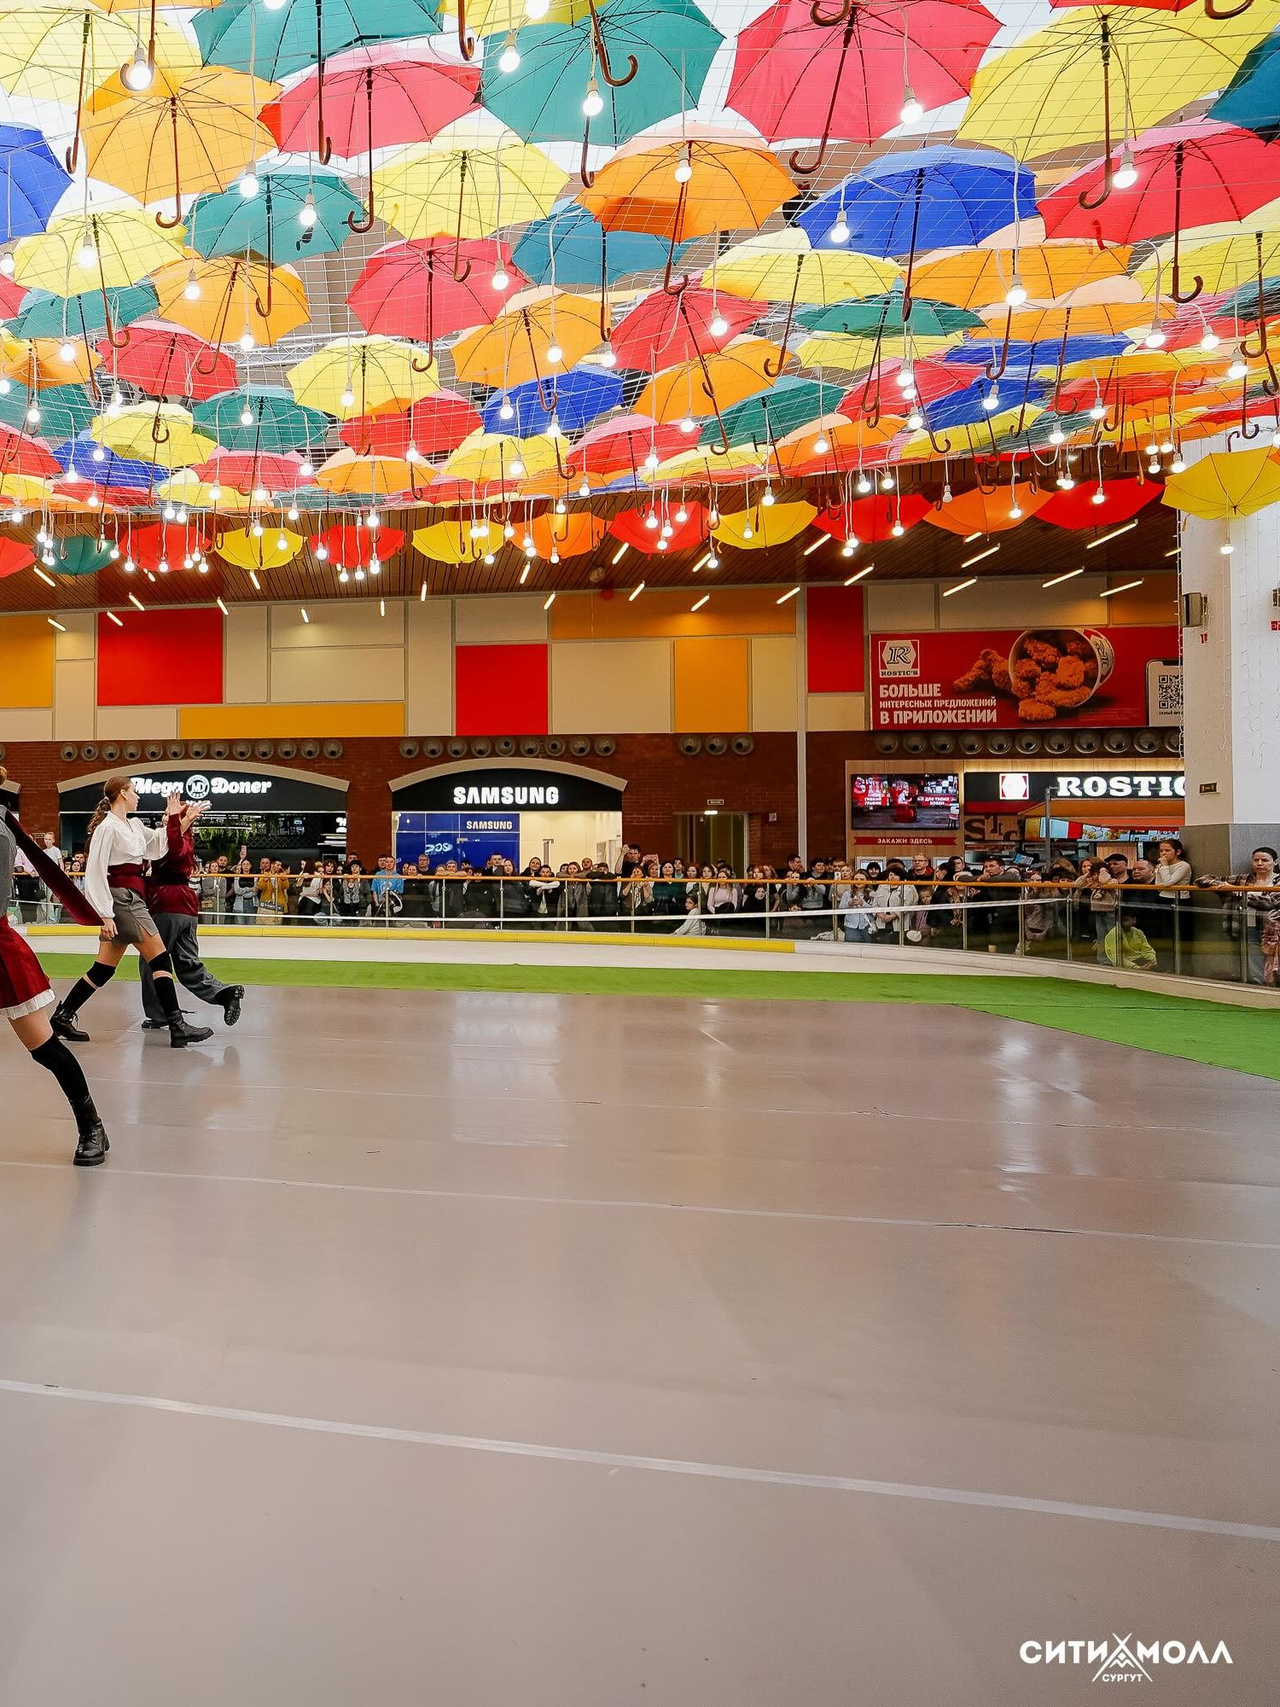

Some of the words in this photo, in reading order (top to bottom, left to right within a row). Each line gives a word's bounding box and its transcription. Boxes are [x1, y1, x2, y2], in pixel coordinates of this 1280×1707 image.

[880, 683, 941, 698] БОЛЬШЕ
[880, 700, 932, 709] ИНТЕРЕСНЫХ
[934, 696, 997, 709] ПРЕДЛОЖЕНИЙ
[880, 711, 890, 724] В
[893, 709, 997, 724] ПРИЛОЖЕНИИ
[130, 777, 183, 797] Mega
[211, 777, 272, 794] Doner
[453, 787, 559, 805] SAMSUNG
[466, 821, 513, 829] SAMSUNG
